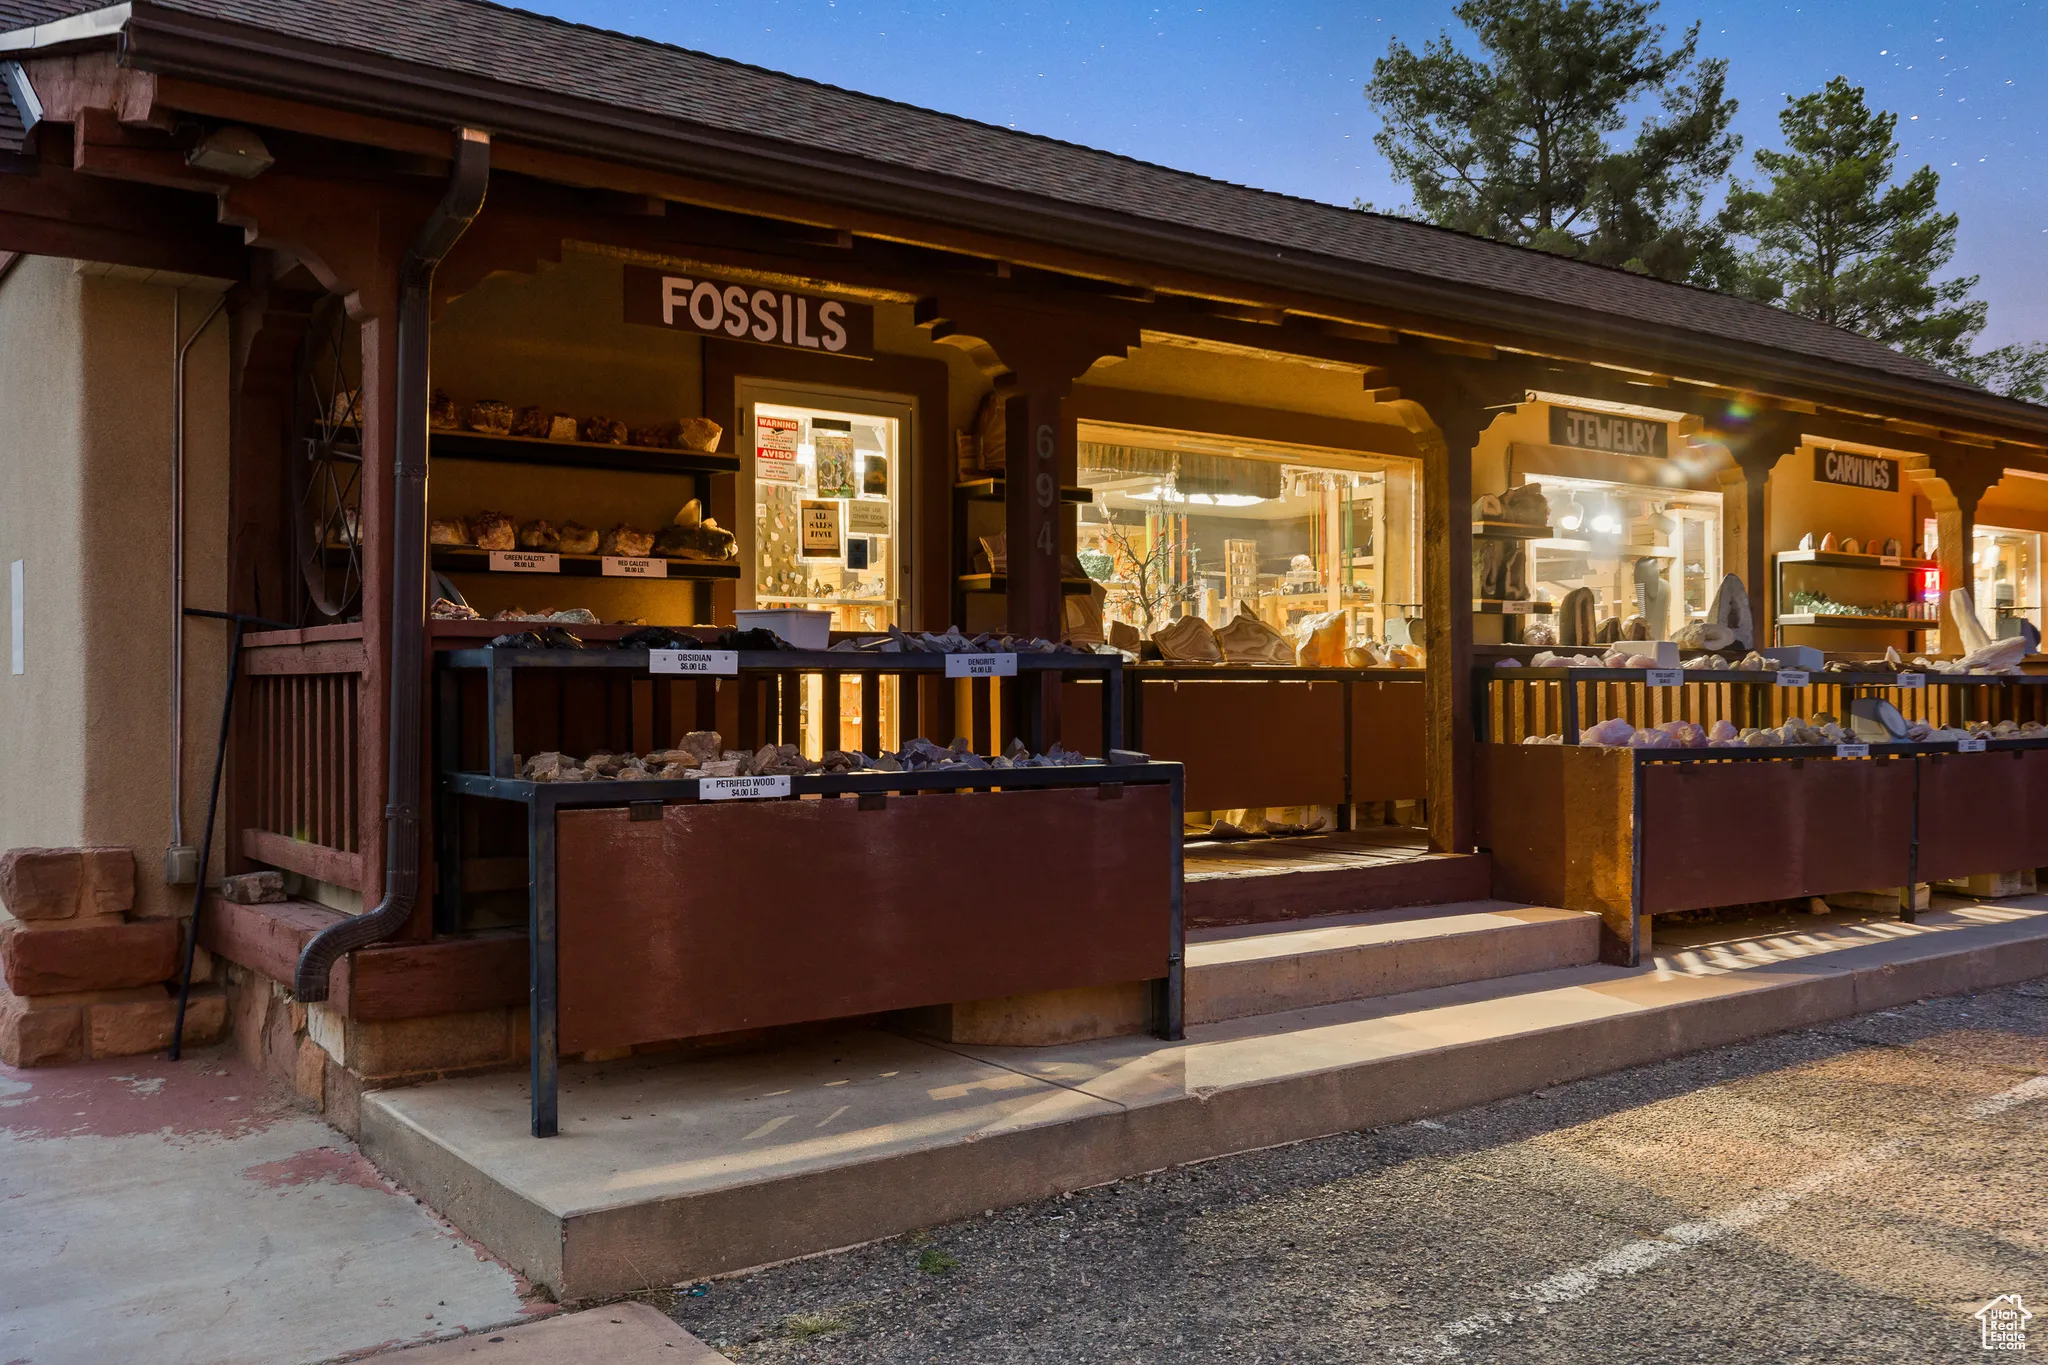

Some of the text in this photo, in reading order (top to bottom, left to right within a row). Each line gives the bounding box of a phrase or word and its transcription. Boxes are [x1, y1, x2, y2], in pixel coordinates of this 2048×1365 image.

[662, 276, 847, 351] FOSSILS
[759, 418, 797, 429] WARNING
[1566, 411, 1657, 454] JEWELRY
[762, 449, 792, 459] AVISO
[1825, 452, 1890, 489] CARVINGS
[810, 530, 832, 538] FINAL
[677, 653, 712, 662] OBSIDIAN
[968, 658, 996, 666] DENDRITE
[698, 662, 709, 670] LB.
[716, 777, 776, 788] PETRIFIED WOOD
[731, 787, 761, 797] $4.00 LB.
